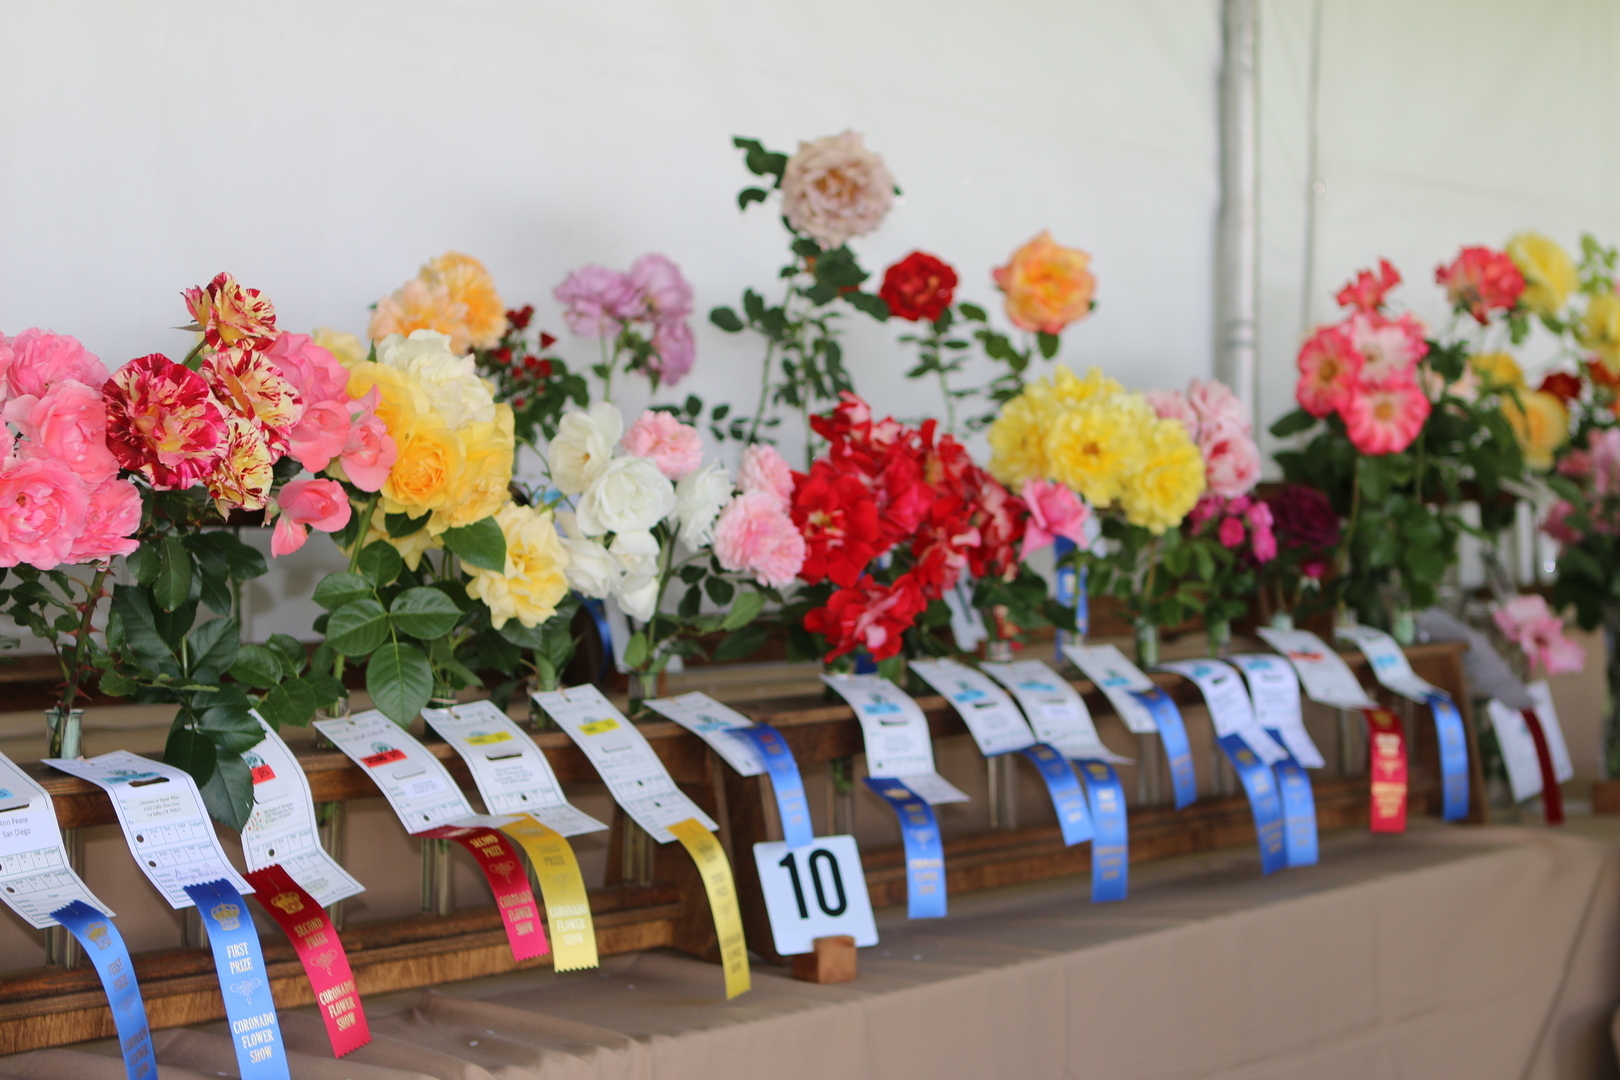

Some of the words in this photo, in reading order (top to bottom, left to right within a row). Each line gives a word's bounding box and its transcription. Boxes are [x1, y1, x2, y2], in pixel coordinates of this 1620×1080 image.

[12, 816, 29, 825] Pease
[2, 829, 15, 838] San
[16, 828, 31, 837] Diego
[469, 834, 498, 849] SECOND
[482, 844, 505, 858] PRIZE
[779, 848, 847, 919] 10
[294, 917, 324, 938] SECOND
[556, 918, 586, 933] FLOWER
[304, 930, 328, 950] PRIZE
[226, 942, 248, 959] FIRST
[229, 957, 254, 975] PRIZE
[318, 979, 355, 1006] CORONADO
[328, 996, 356, 1019] FLOWER
[232, 1012, 275, 1034] CORONADO
[336, 1011, 356, 1032] SHOW
[241, 1029, 274, 1049] FLOWER
[249, 1045, 272, 1064] SHOW
